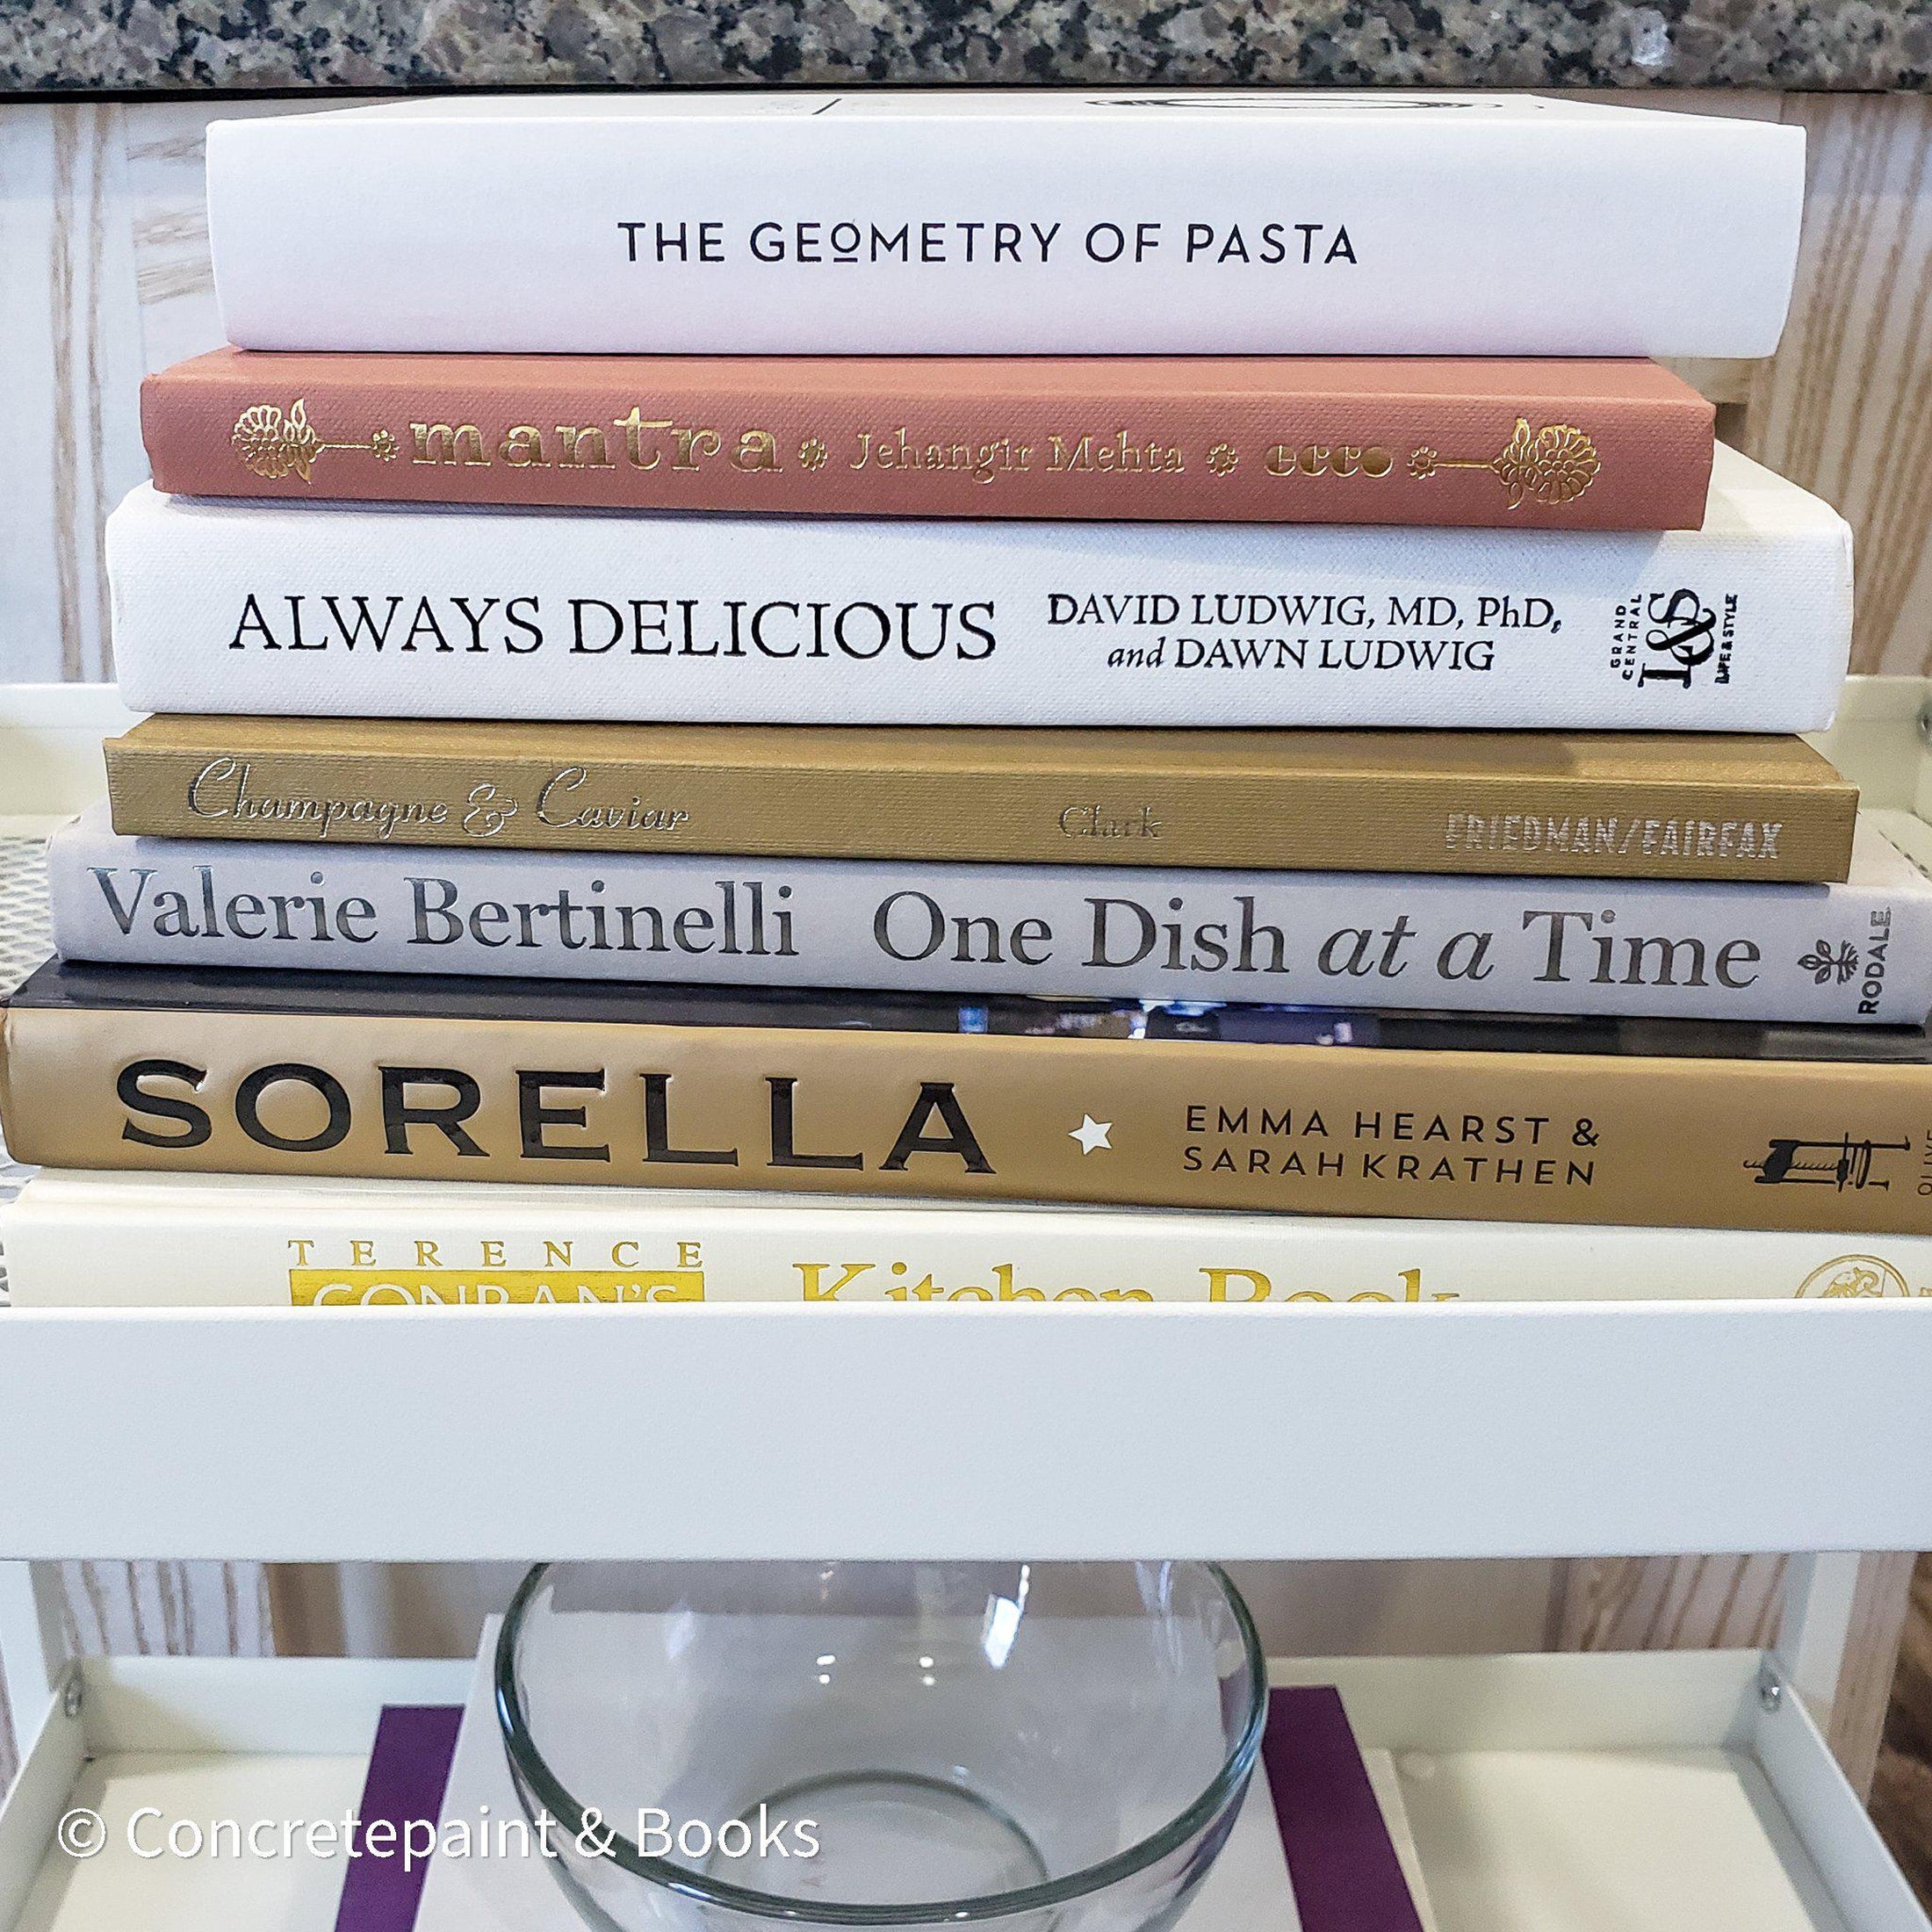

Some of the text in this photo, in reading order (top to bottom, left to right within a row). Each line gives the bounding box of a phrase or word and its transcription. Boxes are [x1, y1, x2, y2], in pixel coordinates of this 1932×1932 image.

[617, 221, 1357, 264] THE GEOMETRY OF PASTA
[409, 407, 784, 472] mantra
[849, 427, 1186, 484] Jehangir Mehta
[228, 593, 996, 660] ALWAYS DELICIOUS
[1048, 593, 1562, 634] DAVID LUDWIG, MD, PhD,
[1610, 604, 1627, 668] GRAND
[1622, 593, 1643, 681] CENTRAL
[1722, 593, 1739, 638] STYLE
[1107, 635, 1495, 671] and DAWN LUDWIG
[188, 757, 691, 840] Champagne & Caviar
[1057, 804, 1164, 840] Clark
[87, 866, 1762, 990] Valerie Bertinelli One Dish at a Time
[1857, 906, 1892, 1014] RODALE
[116, 1058, 997, 1175] SORELLA
[1186, 1105, 1599, 1147] EMMA HEARST &
[1183, 1146, 1596, 1186] SARAH KRATHEN
[288, 1240, 703, 1268] TERENCE
